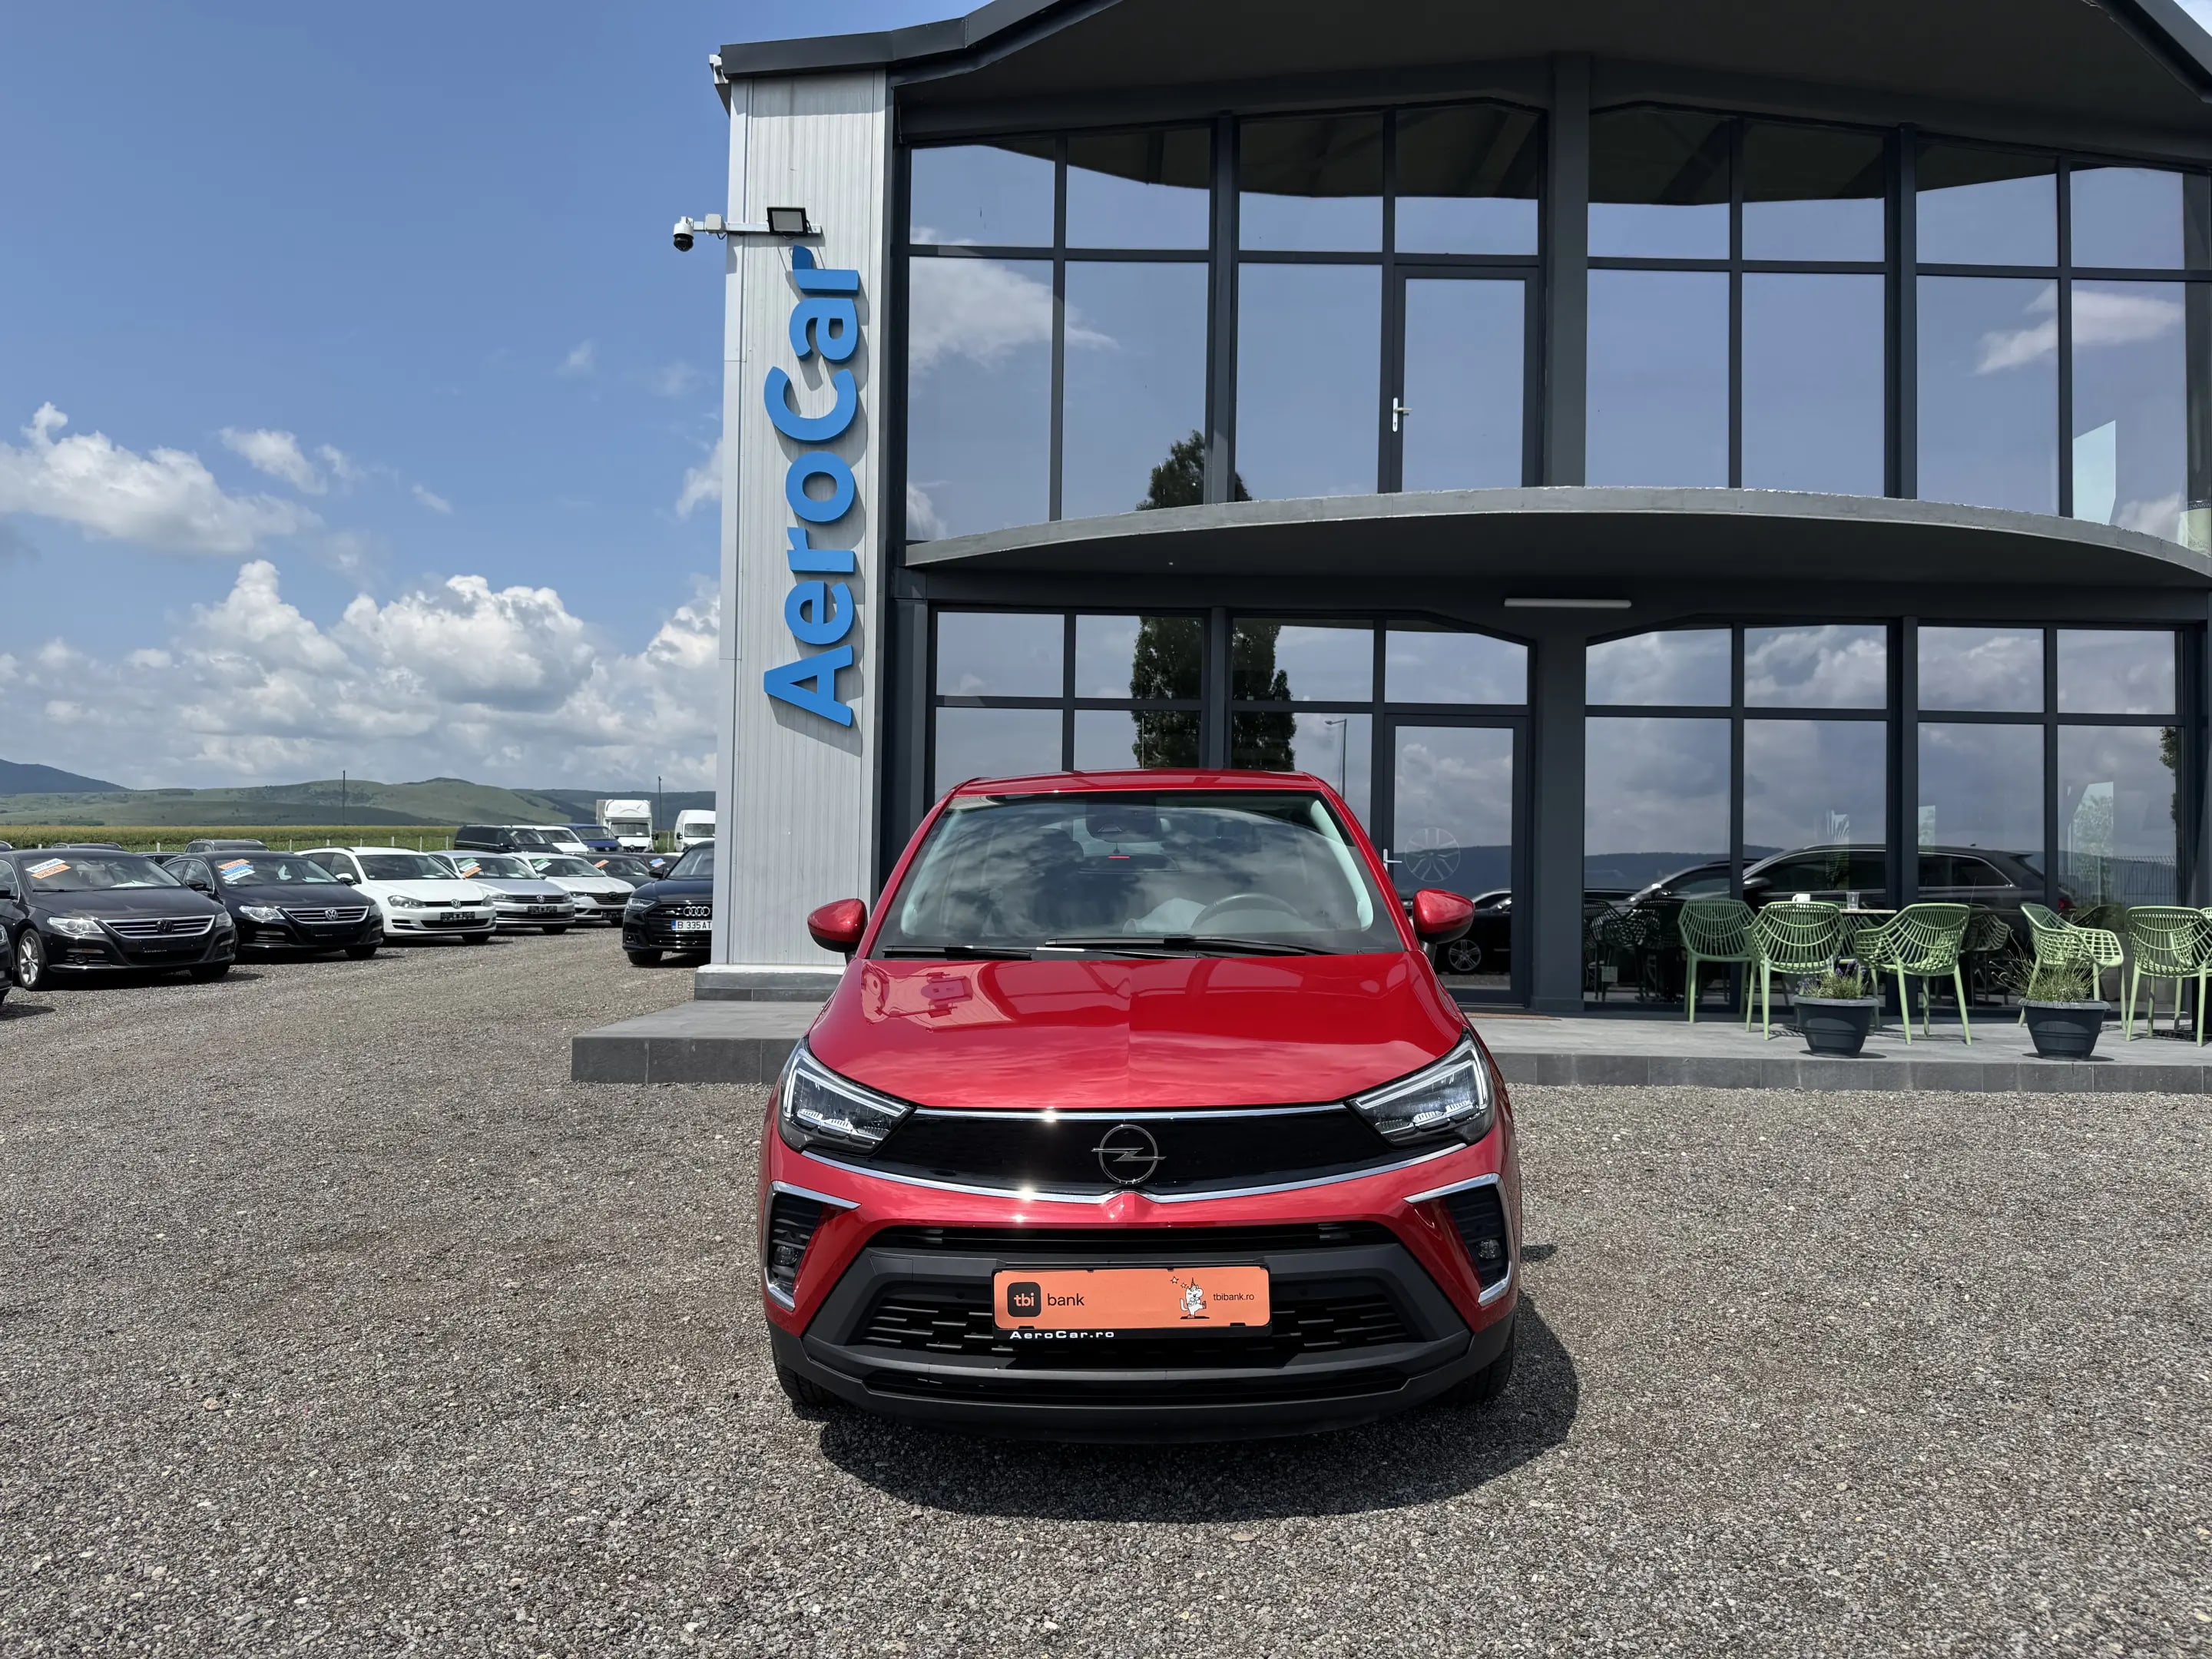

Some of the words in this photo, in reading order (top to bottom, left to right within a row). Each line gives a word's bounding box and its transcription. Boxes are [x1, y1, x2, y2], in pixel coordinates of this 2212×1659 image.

[763, 244, 861, 727] AeroCar
[677, 921, 684, 929] B
[1013, 1292, 1035, 1307] tbi
[1047, 1293, 1084, 1306] bank
[1213, 1293, 1254, 1301] tbibank.ro
[1009, 1330, 1114, 1339] AeroCar.ro
